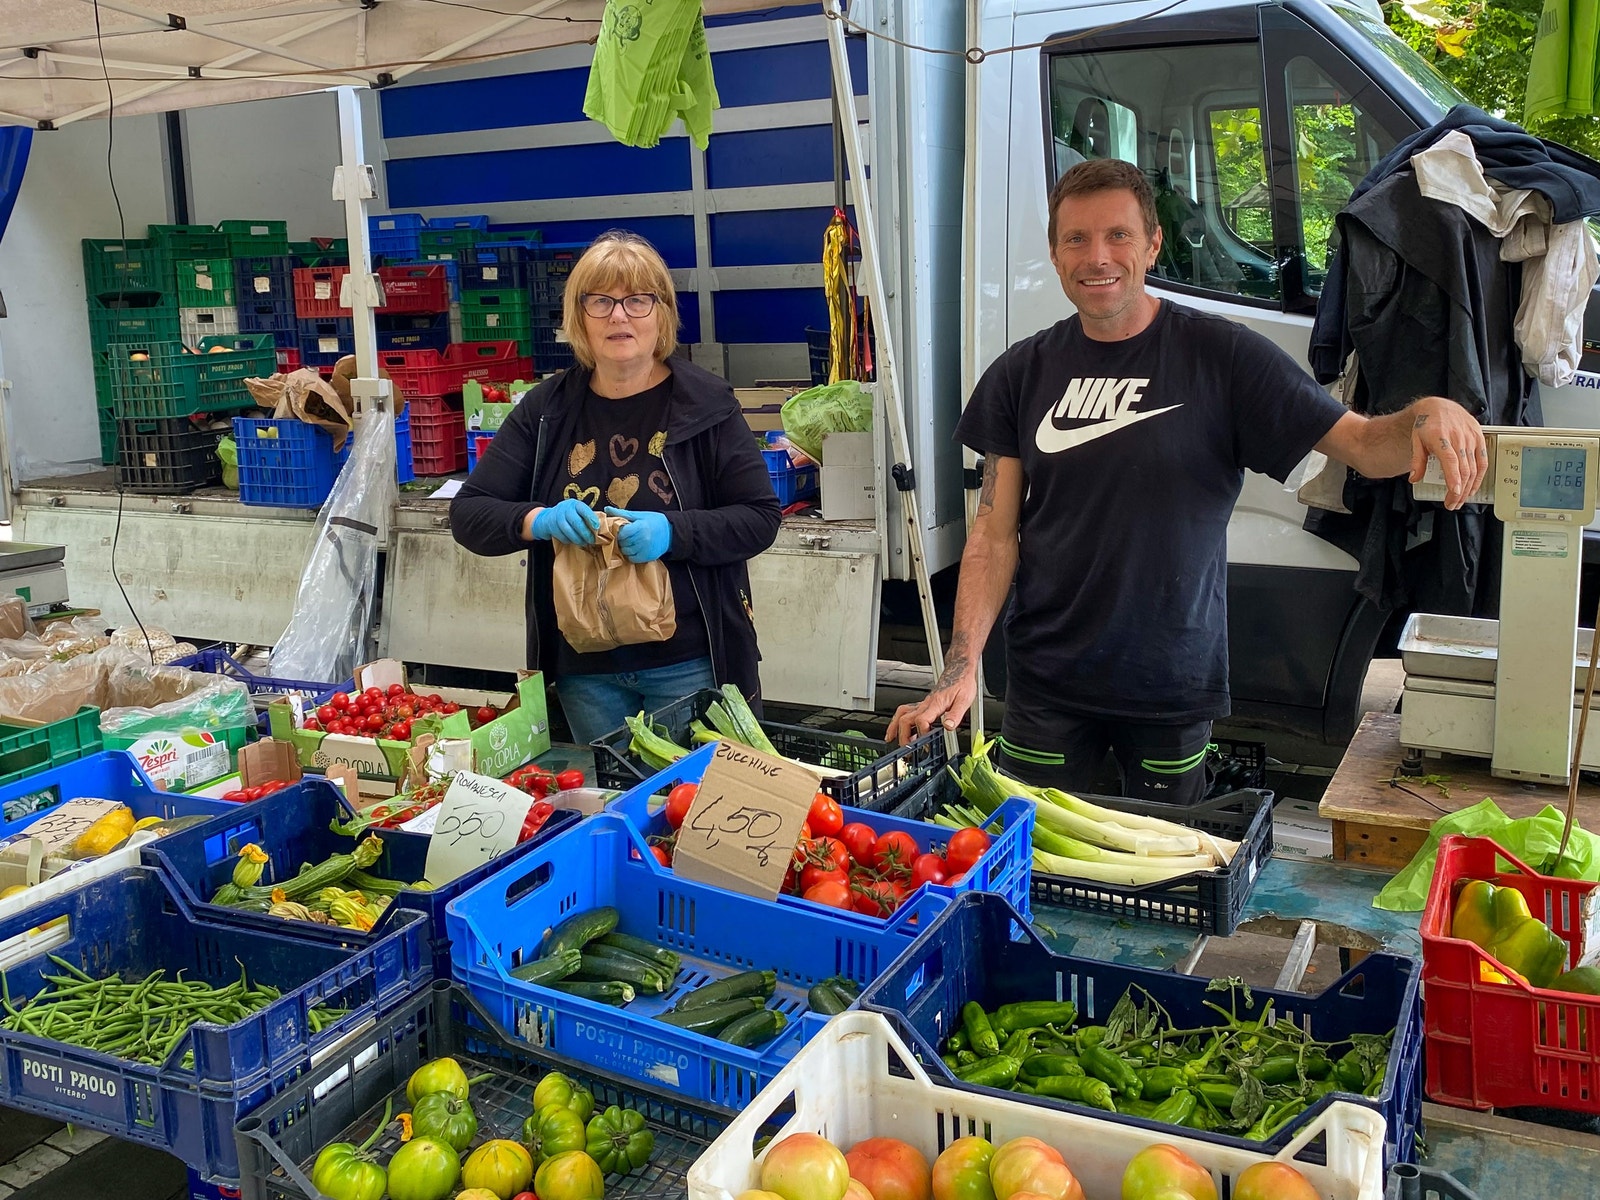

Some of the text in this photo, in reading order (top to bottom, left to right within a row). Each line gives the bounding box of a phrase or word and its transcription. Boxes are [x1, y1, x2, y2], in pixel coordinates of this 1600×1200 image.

[1054, 378, 1150, 419] NIKE
[1569, 375, 1600, 389] RA
[138, 748, 178, 772] Zespri
[481, 742, 521, 776] OP COPLA
[716, 743, 783, 777] ZUCCHINE
[575, 1021, 689, 1070] POSTI PAOLO
[612, 1051, 651, 1069] VITERBO
[23, 1058, 117, 1097] POSTI PAOLO
[55, 1086, 87, 1100] VITERBO
